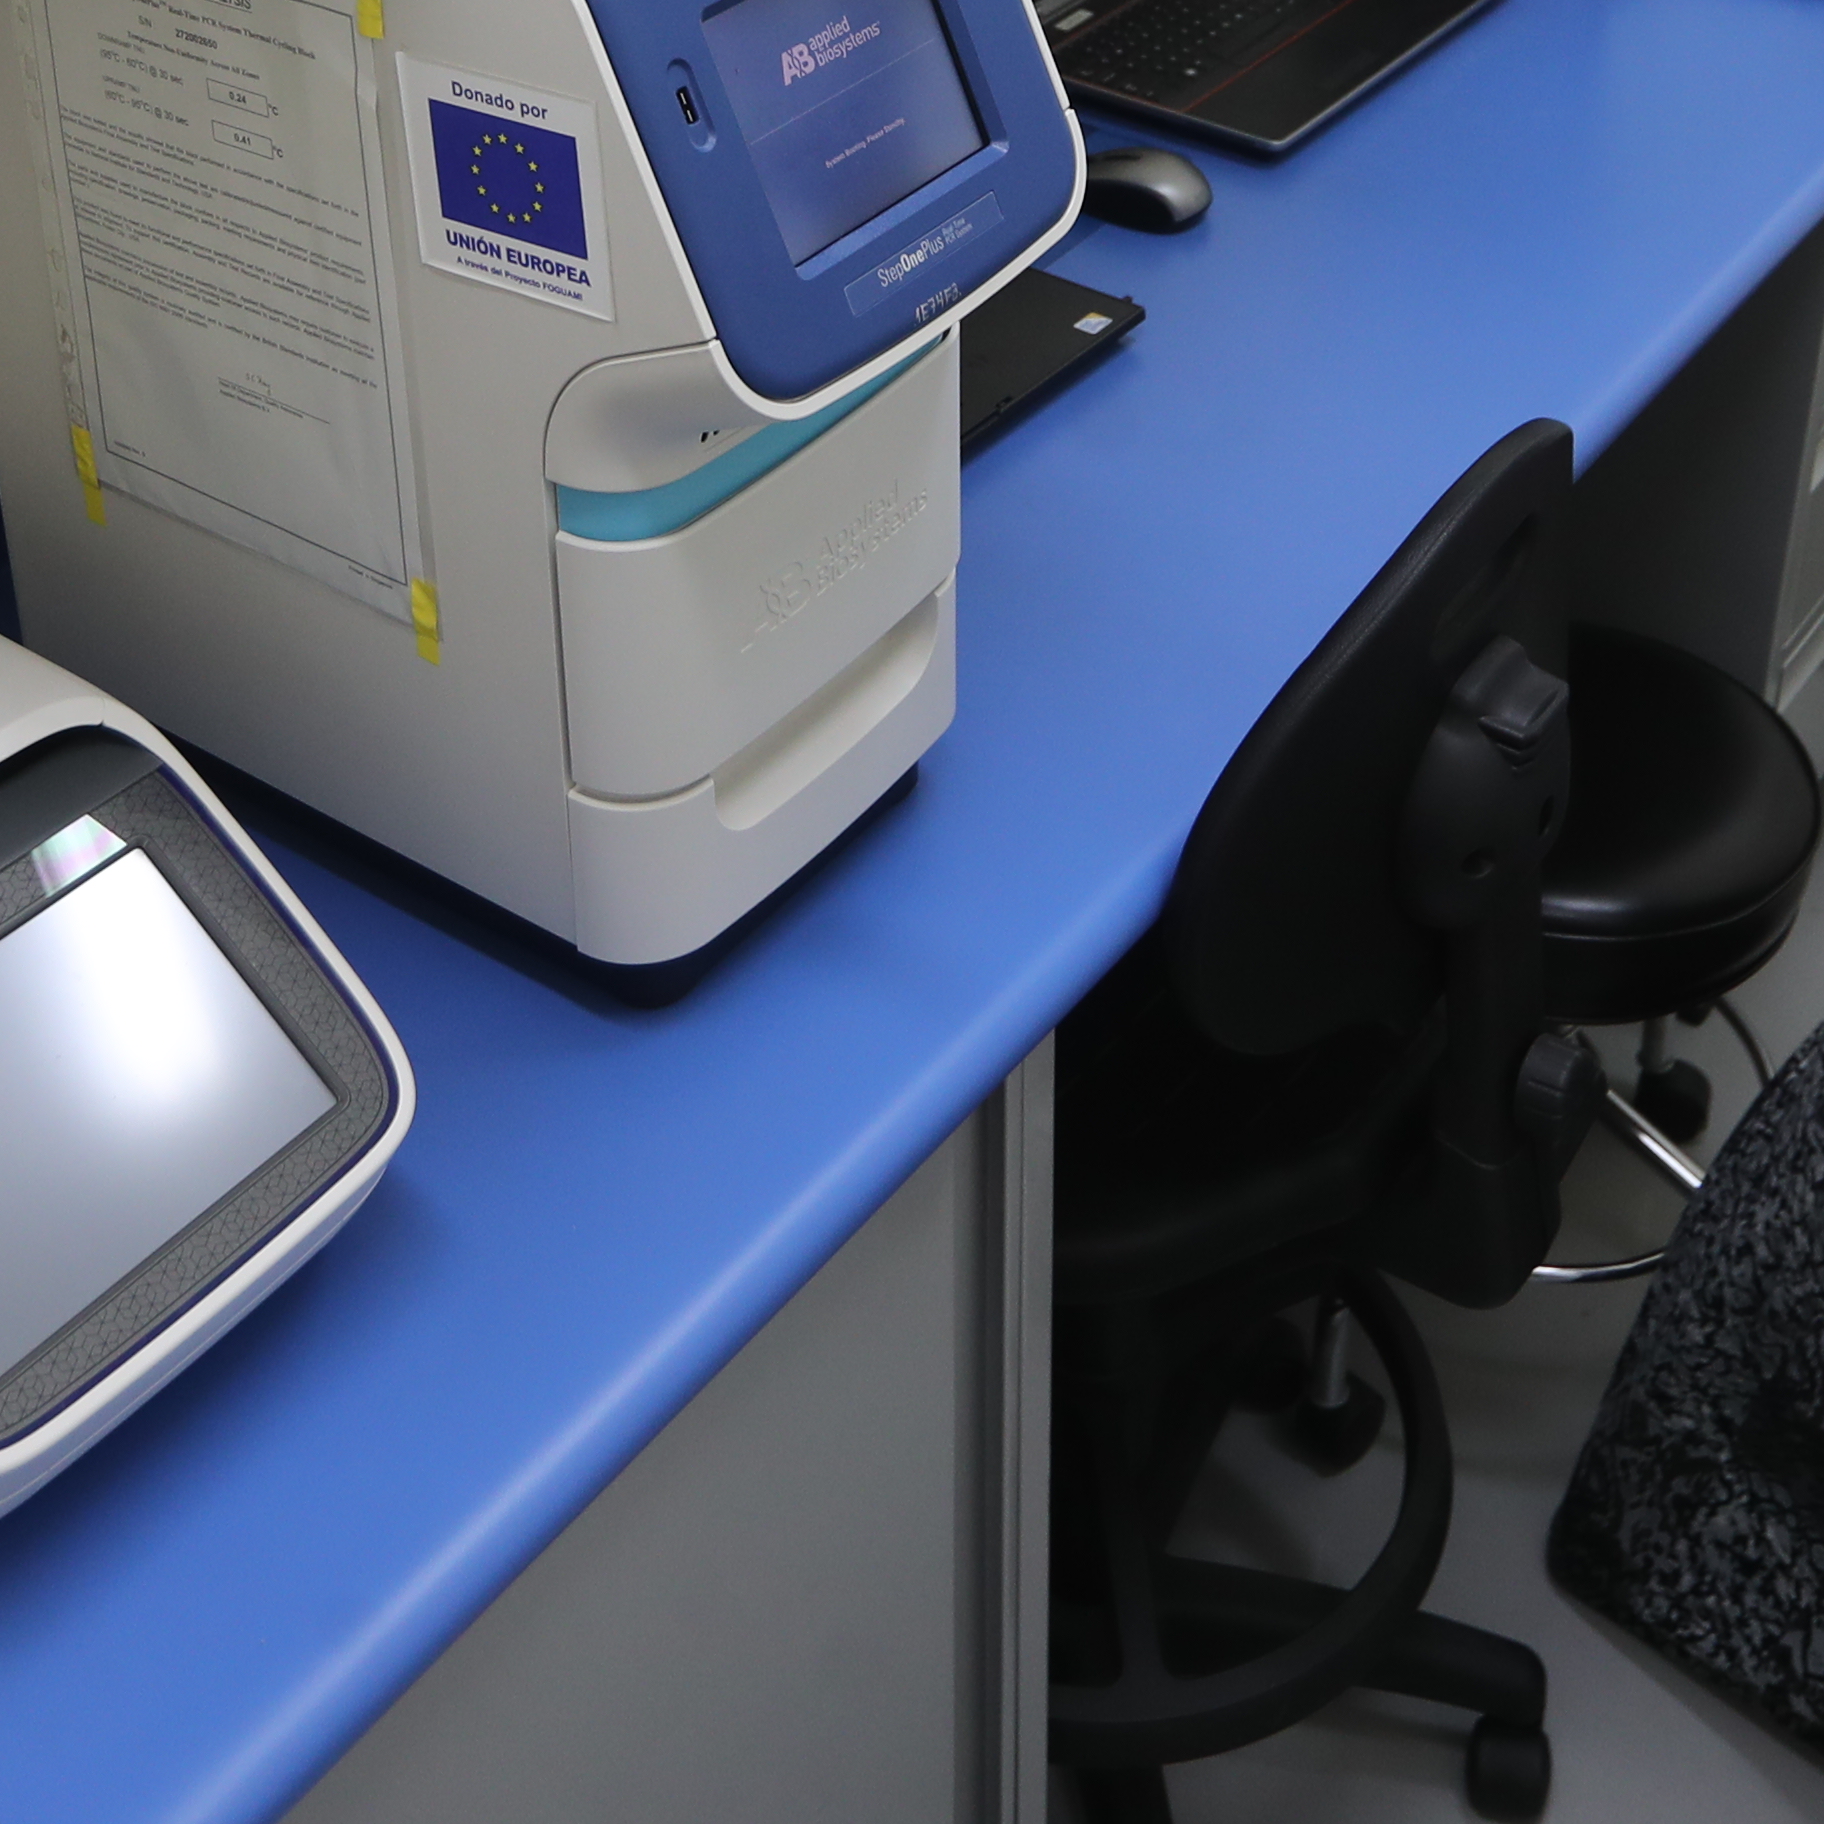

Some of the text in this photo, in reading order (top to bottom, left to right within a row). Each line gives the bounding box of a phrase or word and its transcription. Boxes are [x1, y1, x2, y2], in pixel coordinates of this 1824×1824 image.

[243, 27, 272, 45] Thermal
[780, 14, 851, 87] AB applied
[814, 21, 882, 67] biosystems
[228, 90, 247, 105] 0.24
[450, 80, 549, 120] Donado por
[233, 132, 252, 146] 0.41
[825, 152, 845, 169] System
[866, 129, 885, 144] Please
[444, 228, 593, 288] UNIÓN EUROPEA
[465, 258, 489, 273] través
[490, 265, 504, 276] del
[504, 270, 542, 289] Proyecto
[877, 234, 945, 288] StepOnePlus
[819, 476, 898, 560] Applied
[816, 487, 928, 597] Biosystems
